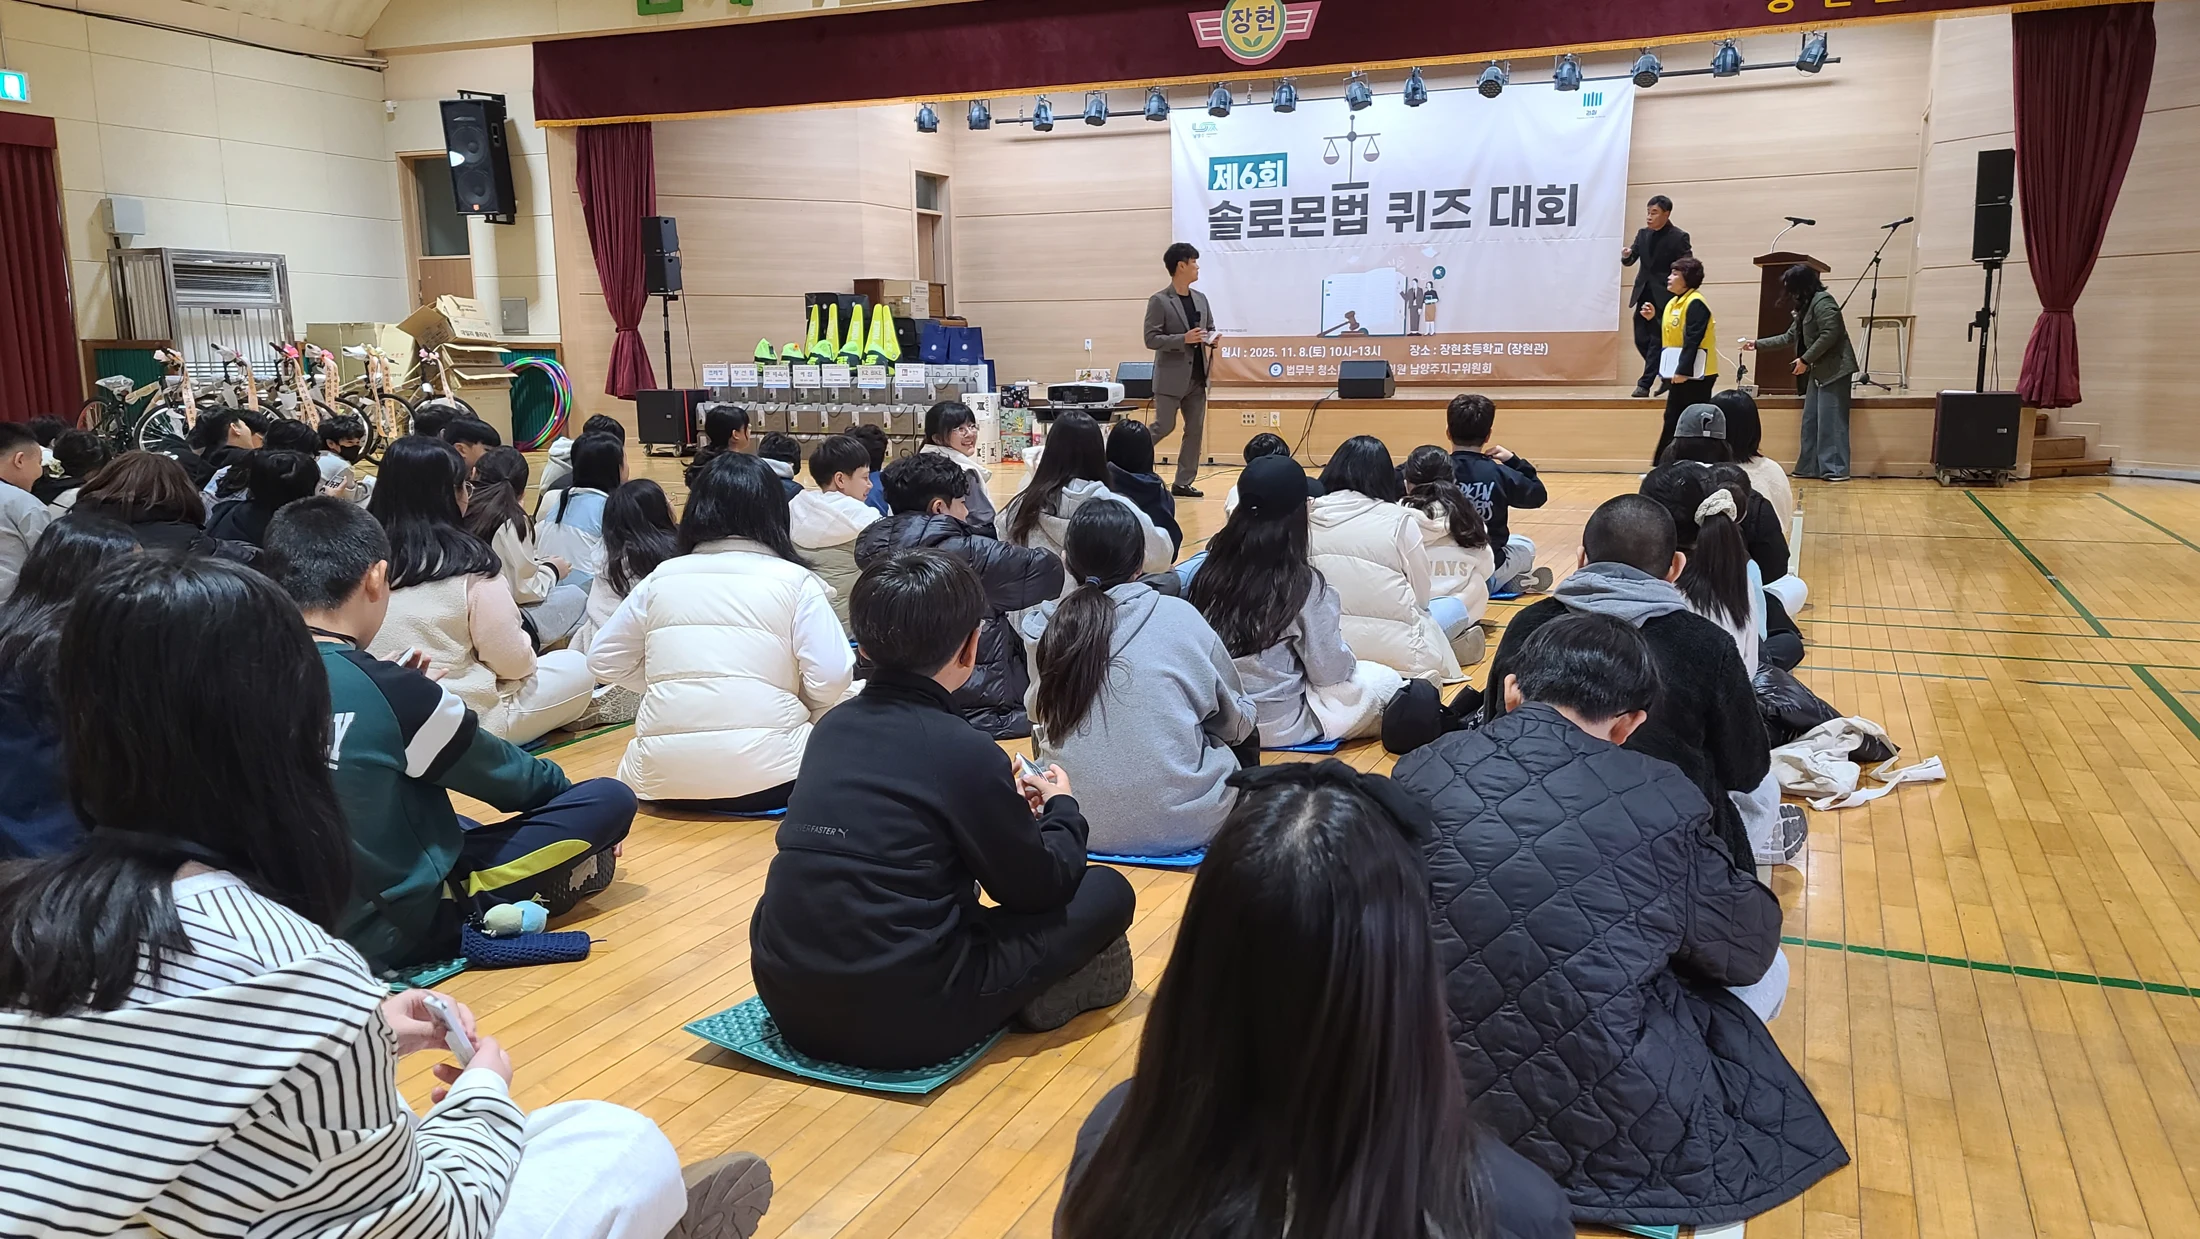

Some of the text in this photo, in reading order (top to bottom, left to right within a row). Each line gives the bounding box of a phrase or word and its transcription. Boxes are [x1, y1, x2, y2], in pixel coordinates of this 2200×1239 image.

[1231, 5, 1275, 34] 장현
[1212, 160, 1284, 190] 제6회
[1208, 184, 1579, 240] 솔로몬법 퀴즈 대회
[1221, 346, 1241, 359] 일시
[1250, 347, 1278, 358] 2025.
[1281, 347, 1297, 357] 11.
[1299, 345, 1326, 358] 8.(토)
[1330, 345, 1381, 358] 10시~13시
[1409, 344, 1431, 357] 장소
[1440, 342, 1504, 356] 장현초등학교
[1507, 342, 1549, 356] (장현관)
[1286, 364, 1314, 376] 법무부
[1318, 364, 1340, 376] 청소
[1410, 362, 1492, 376] 남양주지구위원회
[1430, 560, 1468, 577] AYS
